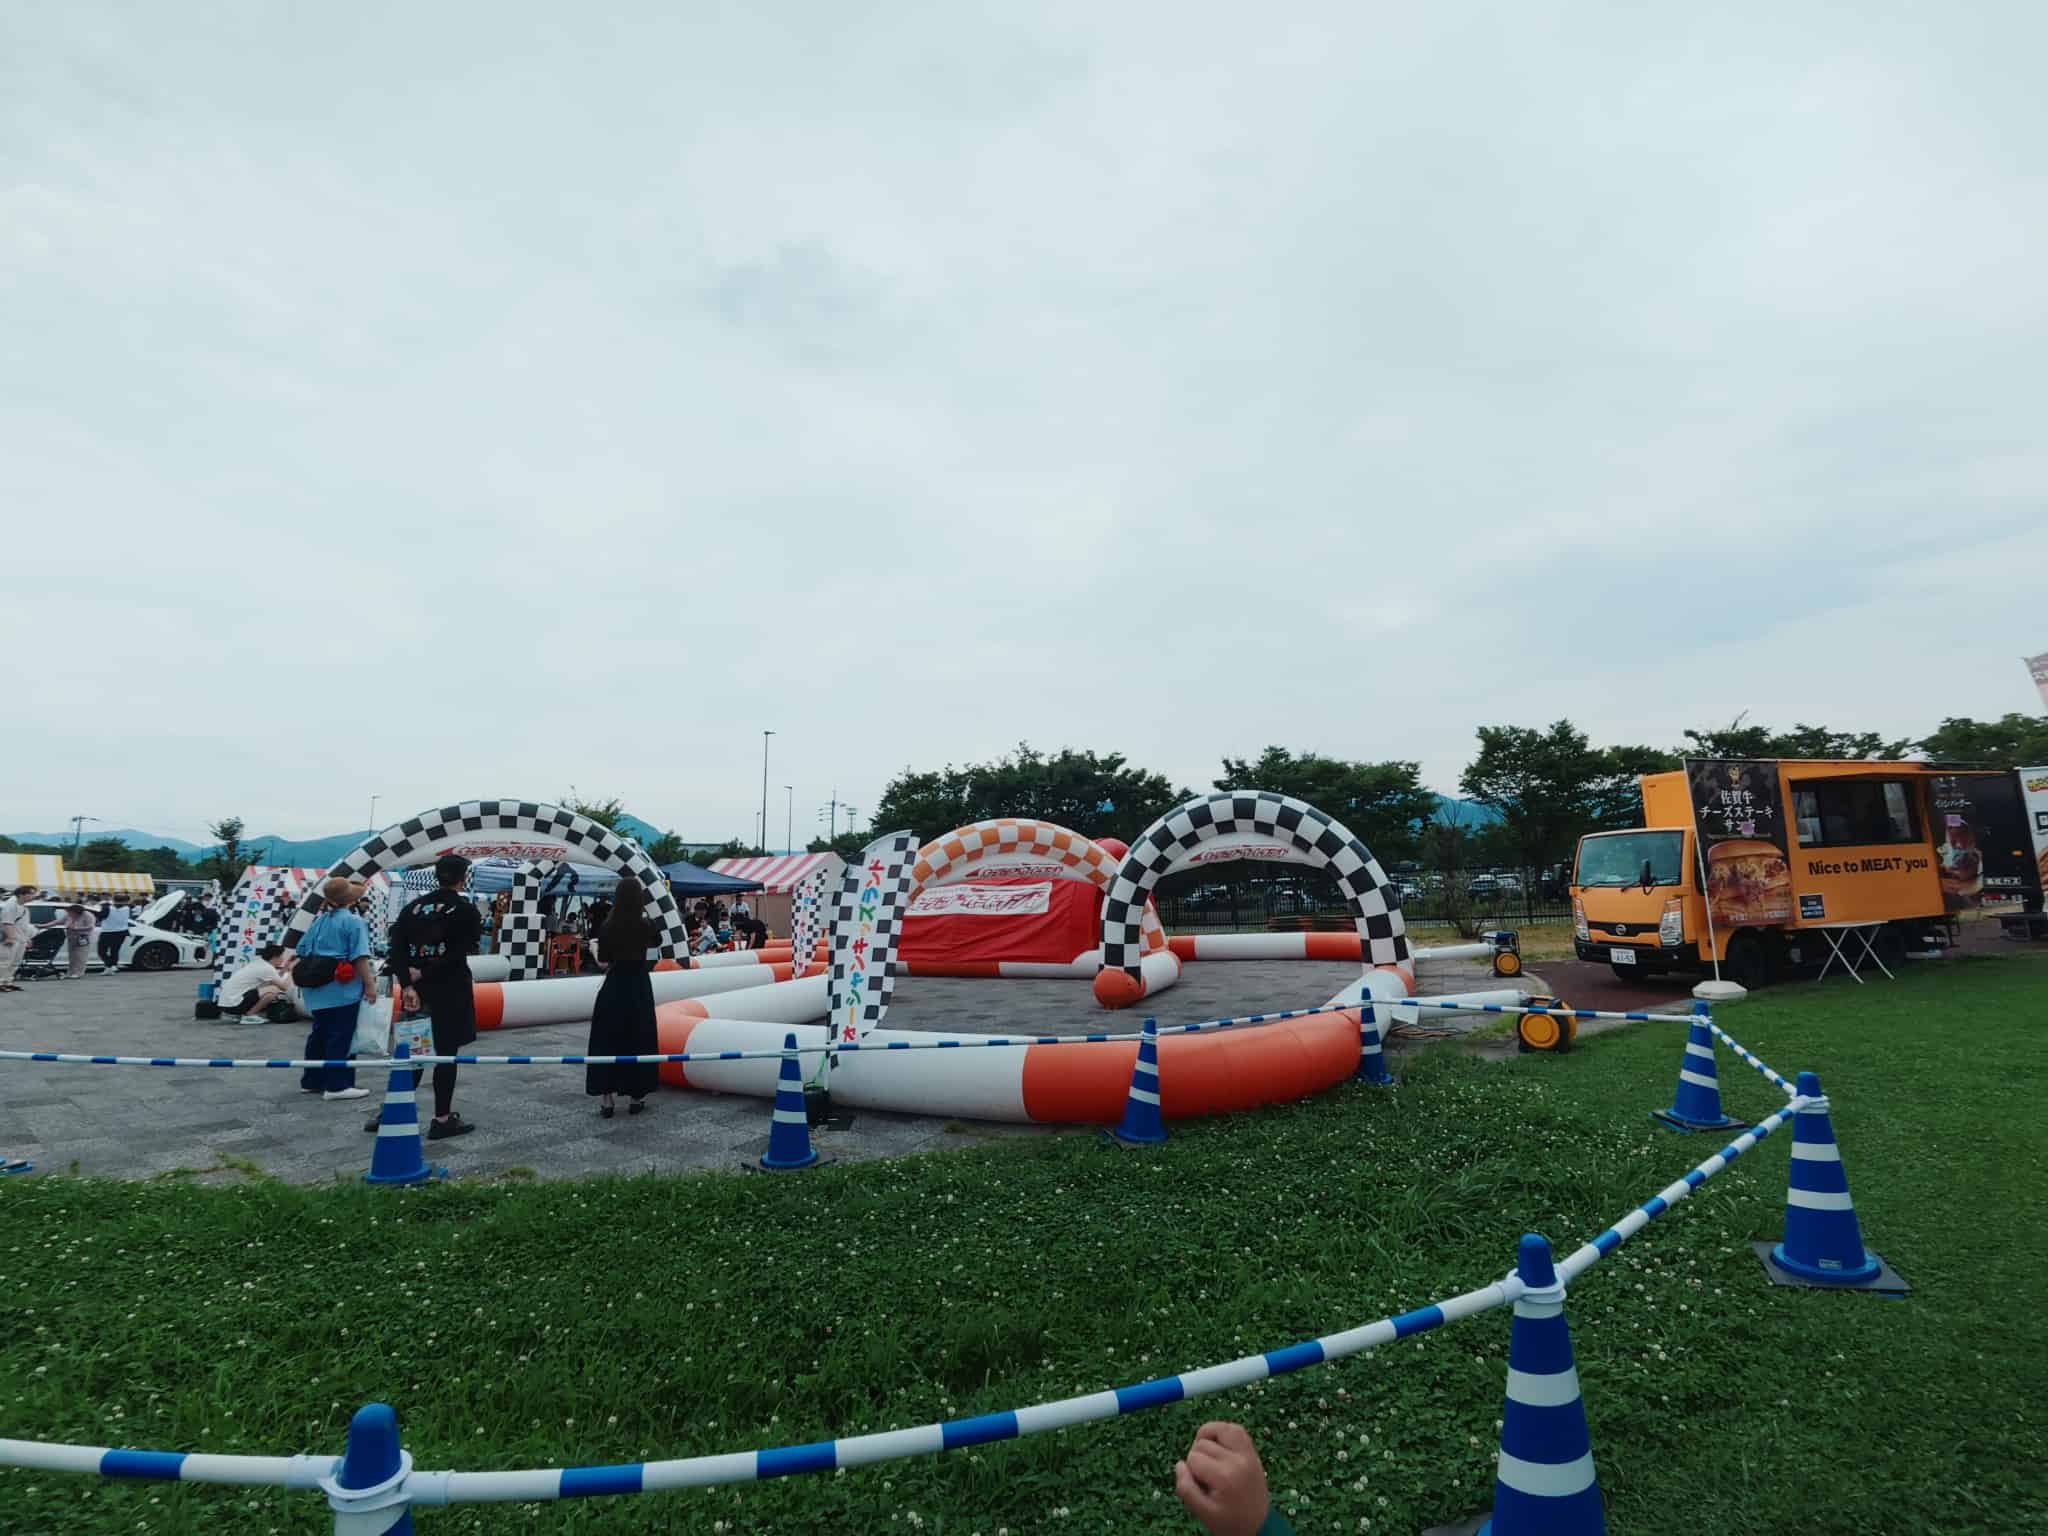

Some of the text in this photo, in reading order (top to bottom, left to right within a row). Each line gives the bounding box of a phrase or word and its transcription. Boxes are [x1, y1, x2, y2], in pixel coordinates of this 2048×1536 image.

[1700, 805, 1774, 819] チーズステーキ
[1808, 858, 1929, 876] Nice to MEAT you
